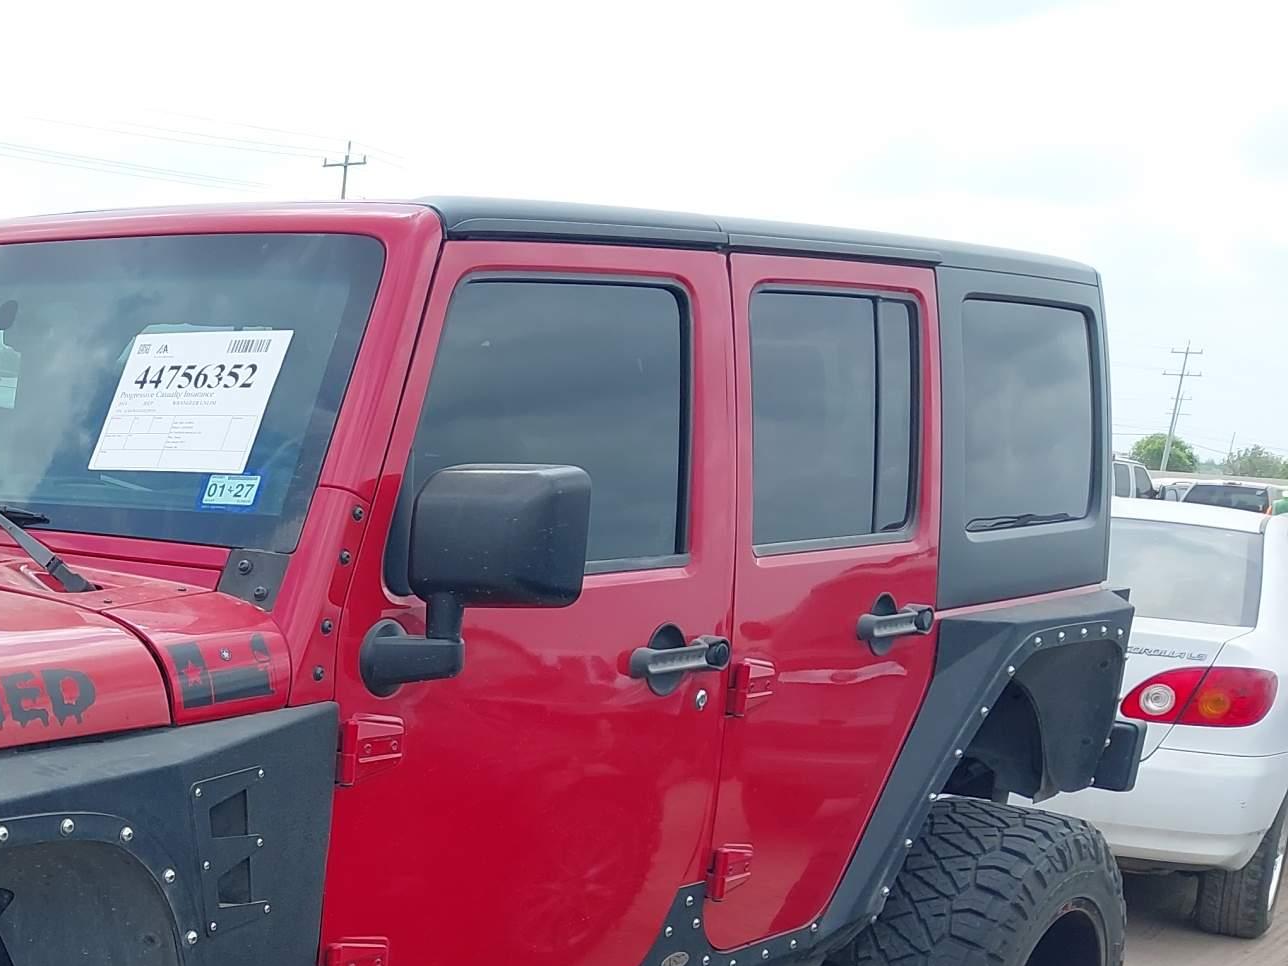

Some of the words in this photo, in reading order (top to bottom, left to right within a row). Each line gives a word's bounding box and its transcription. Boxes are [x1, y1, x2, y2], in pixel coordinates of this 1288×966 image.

[134, 363, 258, 389] 44756352
[120, 391, 154, 400] Progressive
[155, 390, 183, 400] Casualty
[183, 390, 214, 398] Insurance
